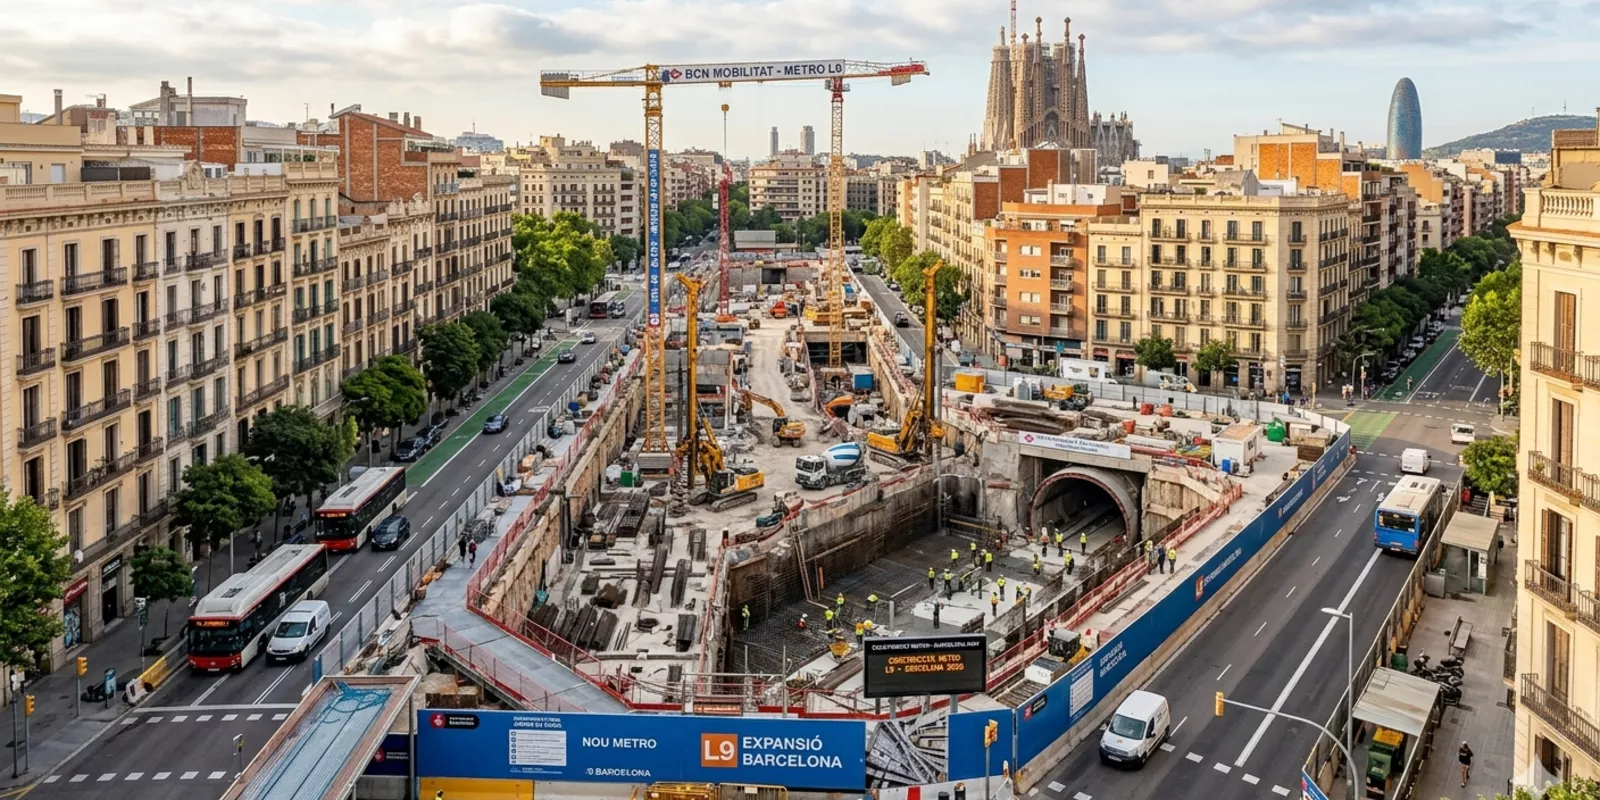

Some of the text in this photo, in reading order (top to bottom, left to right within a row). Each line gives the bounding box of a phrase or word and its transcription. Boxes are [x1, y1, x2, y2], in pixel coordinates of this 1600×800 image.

[685, 69, 710, 79] BCN
[713, 66, 774, 78] MOBILITAT
[784, 64, 826, 76] METRO
[582, 736, 657, 749] NOU METRO
[742, 735, 823, 751] EXPANSIÓ
[704, 740, 735, 761] L9
[742, 753, 843, 768] BARCELONA
[595, 767, 651, 777] BARCELONA
